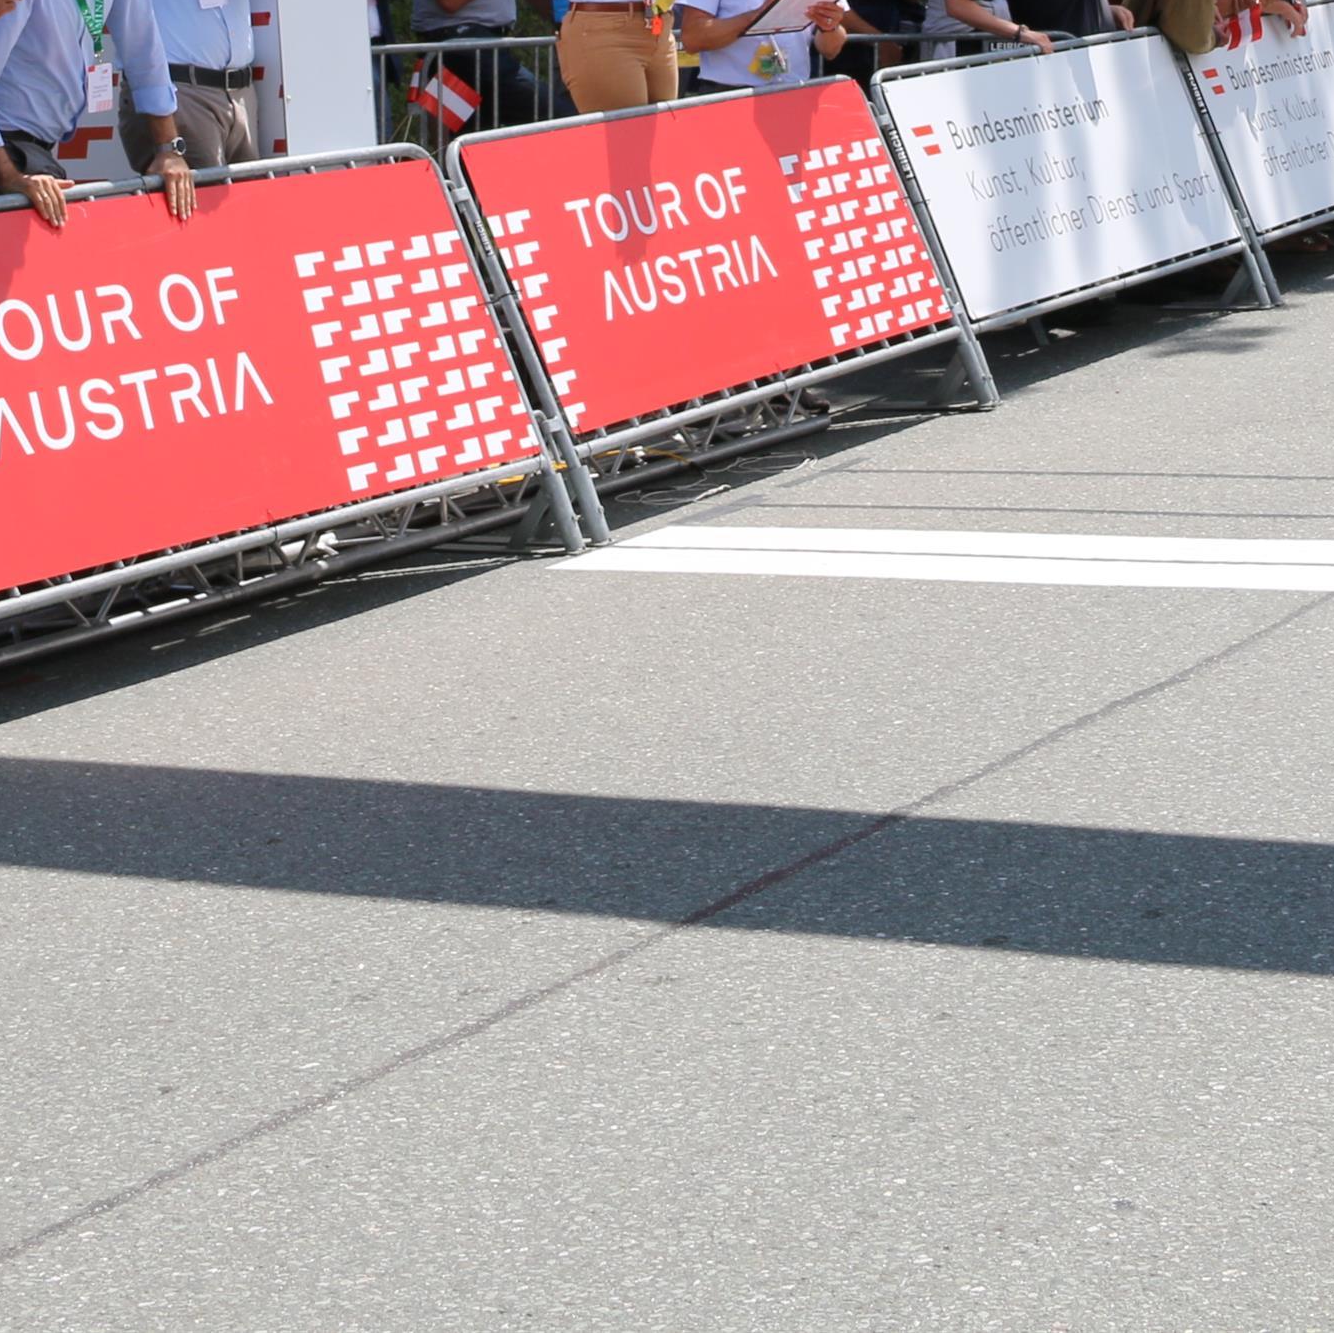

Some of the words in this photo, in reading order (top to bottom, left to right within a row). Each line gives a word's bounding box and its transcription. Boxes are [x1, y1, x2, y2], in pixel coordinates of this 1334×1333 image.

[945, 97, 1110, 150] Bundesministerium
[1262, 136, 1330, 178] öffentlicher
[563, 178, 690, 245] TOUR
[693, 166, 748, 228] OF
[965, 162, 1029, 202] Kunst,
[1024, 149, 1087, 188] Kultur,
[986, 206, 1088, 253] öffentlicher
[1086, 184, 1145, 225] Dienst
[1145, 180, 1177, 210] und
[1172, 170, 1217, 207] Sport
[157, 266, 243, 335] OF
[602, 233, 780, 322] AUSTRIA
